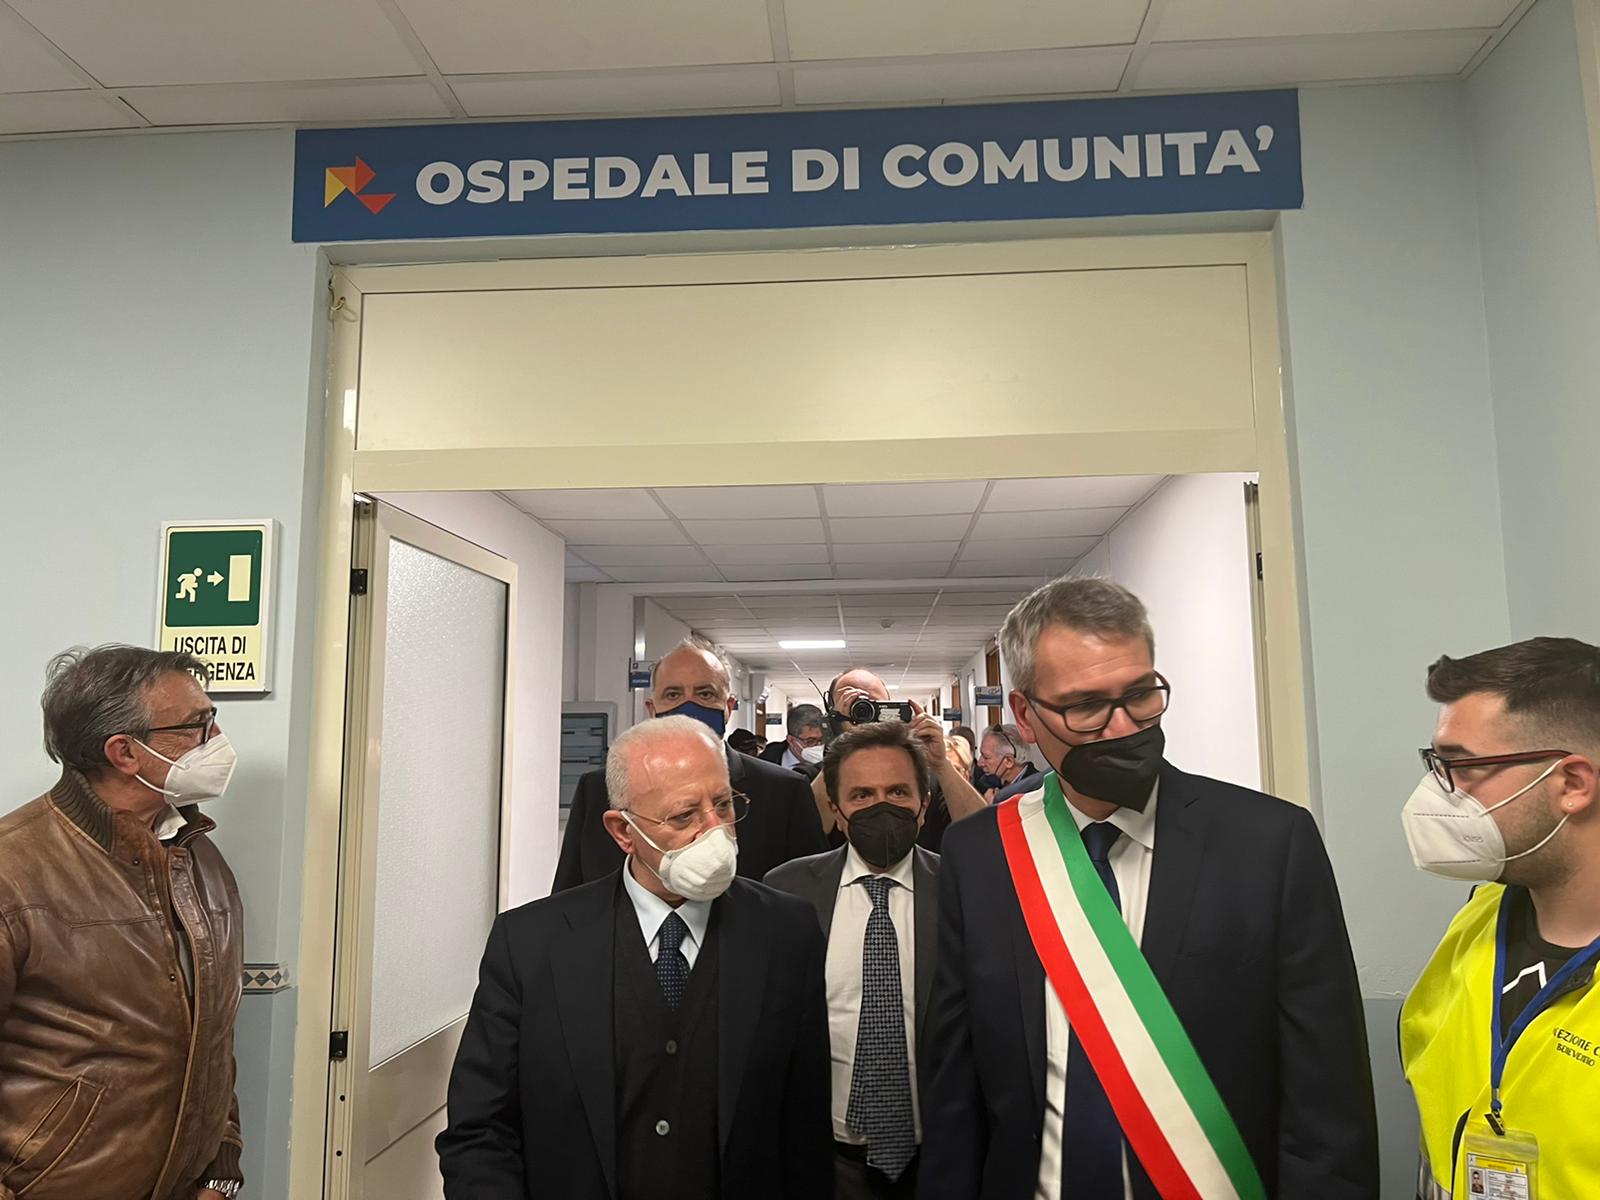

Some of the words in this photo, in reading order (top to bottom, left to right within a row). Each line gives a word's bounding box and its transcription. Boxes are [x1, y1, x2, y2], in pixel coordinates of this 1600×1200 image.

[415, 150, 770, 206] OSPEDALE
[791, 146, 860, 193] DI
[882, 124, 1275, 190] COMUNITA’
[174, 635, 227, 655] USCITA
[231, 635, 246, 655] DI
